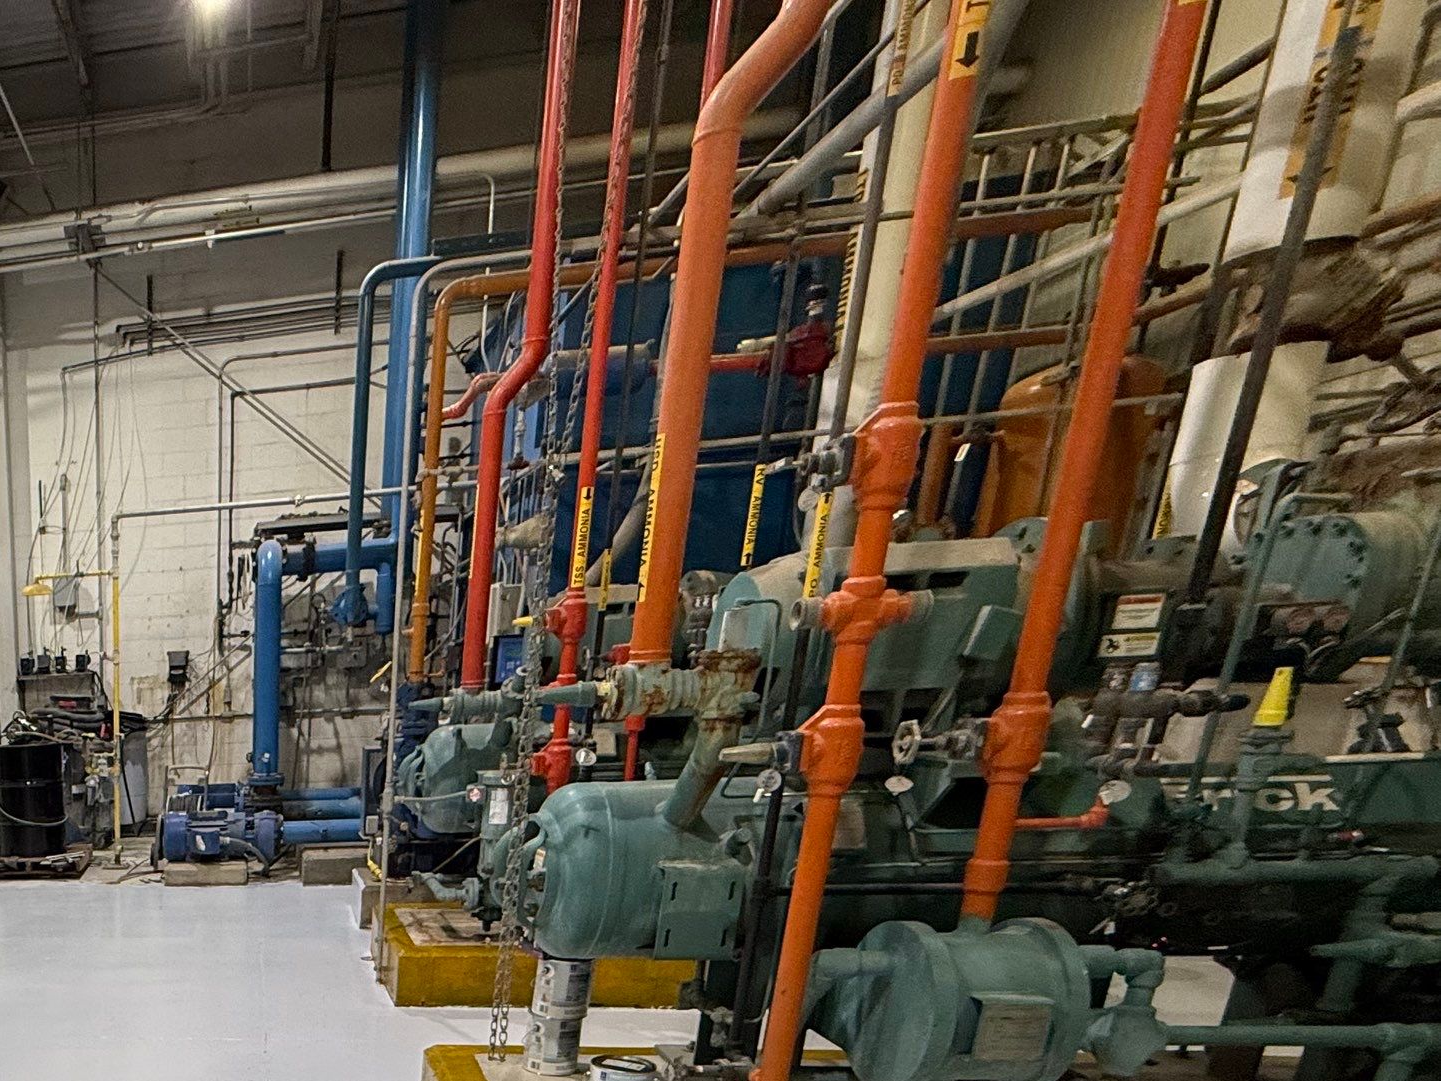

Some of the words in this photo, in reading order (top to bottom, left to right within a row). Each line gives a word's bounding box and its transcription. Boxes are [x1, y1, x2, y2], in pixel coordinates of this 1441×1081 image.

[577, 508, 591, 557] AMMONIA
[745, 495, 763, 545] AMMONIA
[813, 513, 830, 568] AMMONIA
[573, 565, 585, 586] TSS
